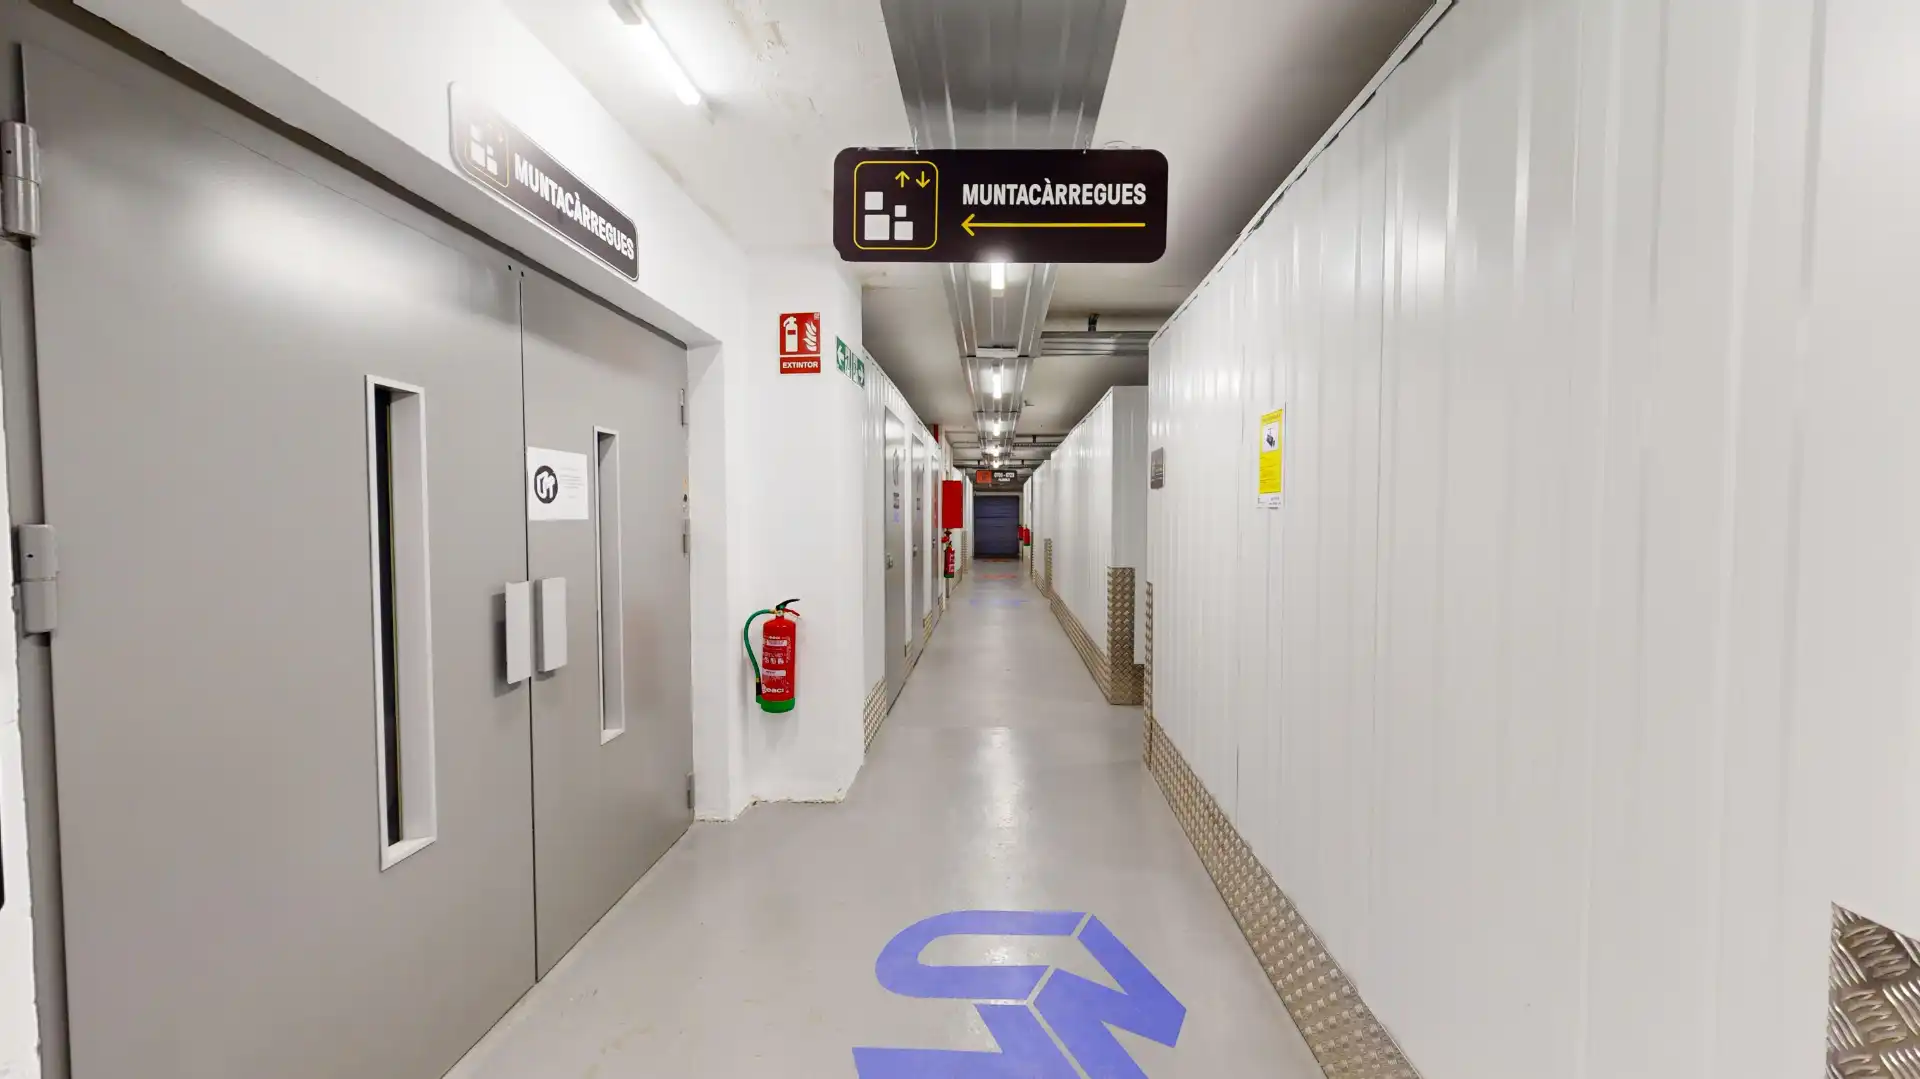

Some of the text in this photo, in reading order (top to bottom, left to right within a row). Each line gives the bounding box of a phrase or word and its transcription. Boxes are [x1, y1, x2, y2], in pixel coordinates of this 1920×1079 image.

[962, 178, 1147, 206] MUNTACÀRREGUES
[514, 153, 635, 260] MUNTACÀRREGUES
[782, 361, 819, 369] EXTINTOR
